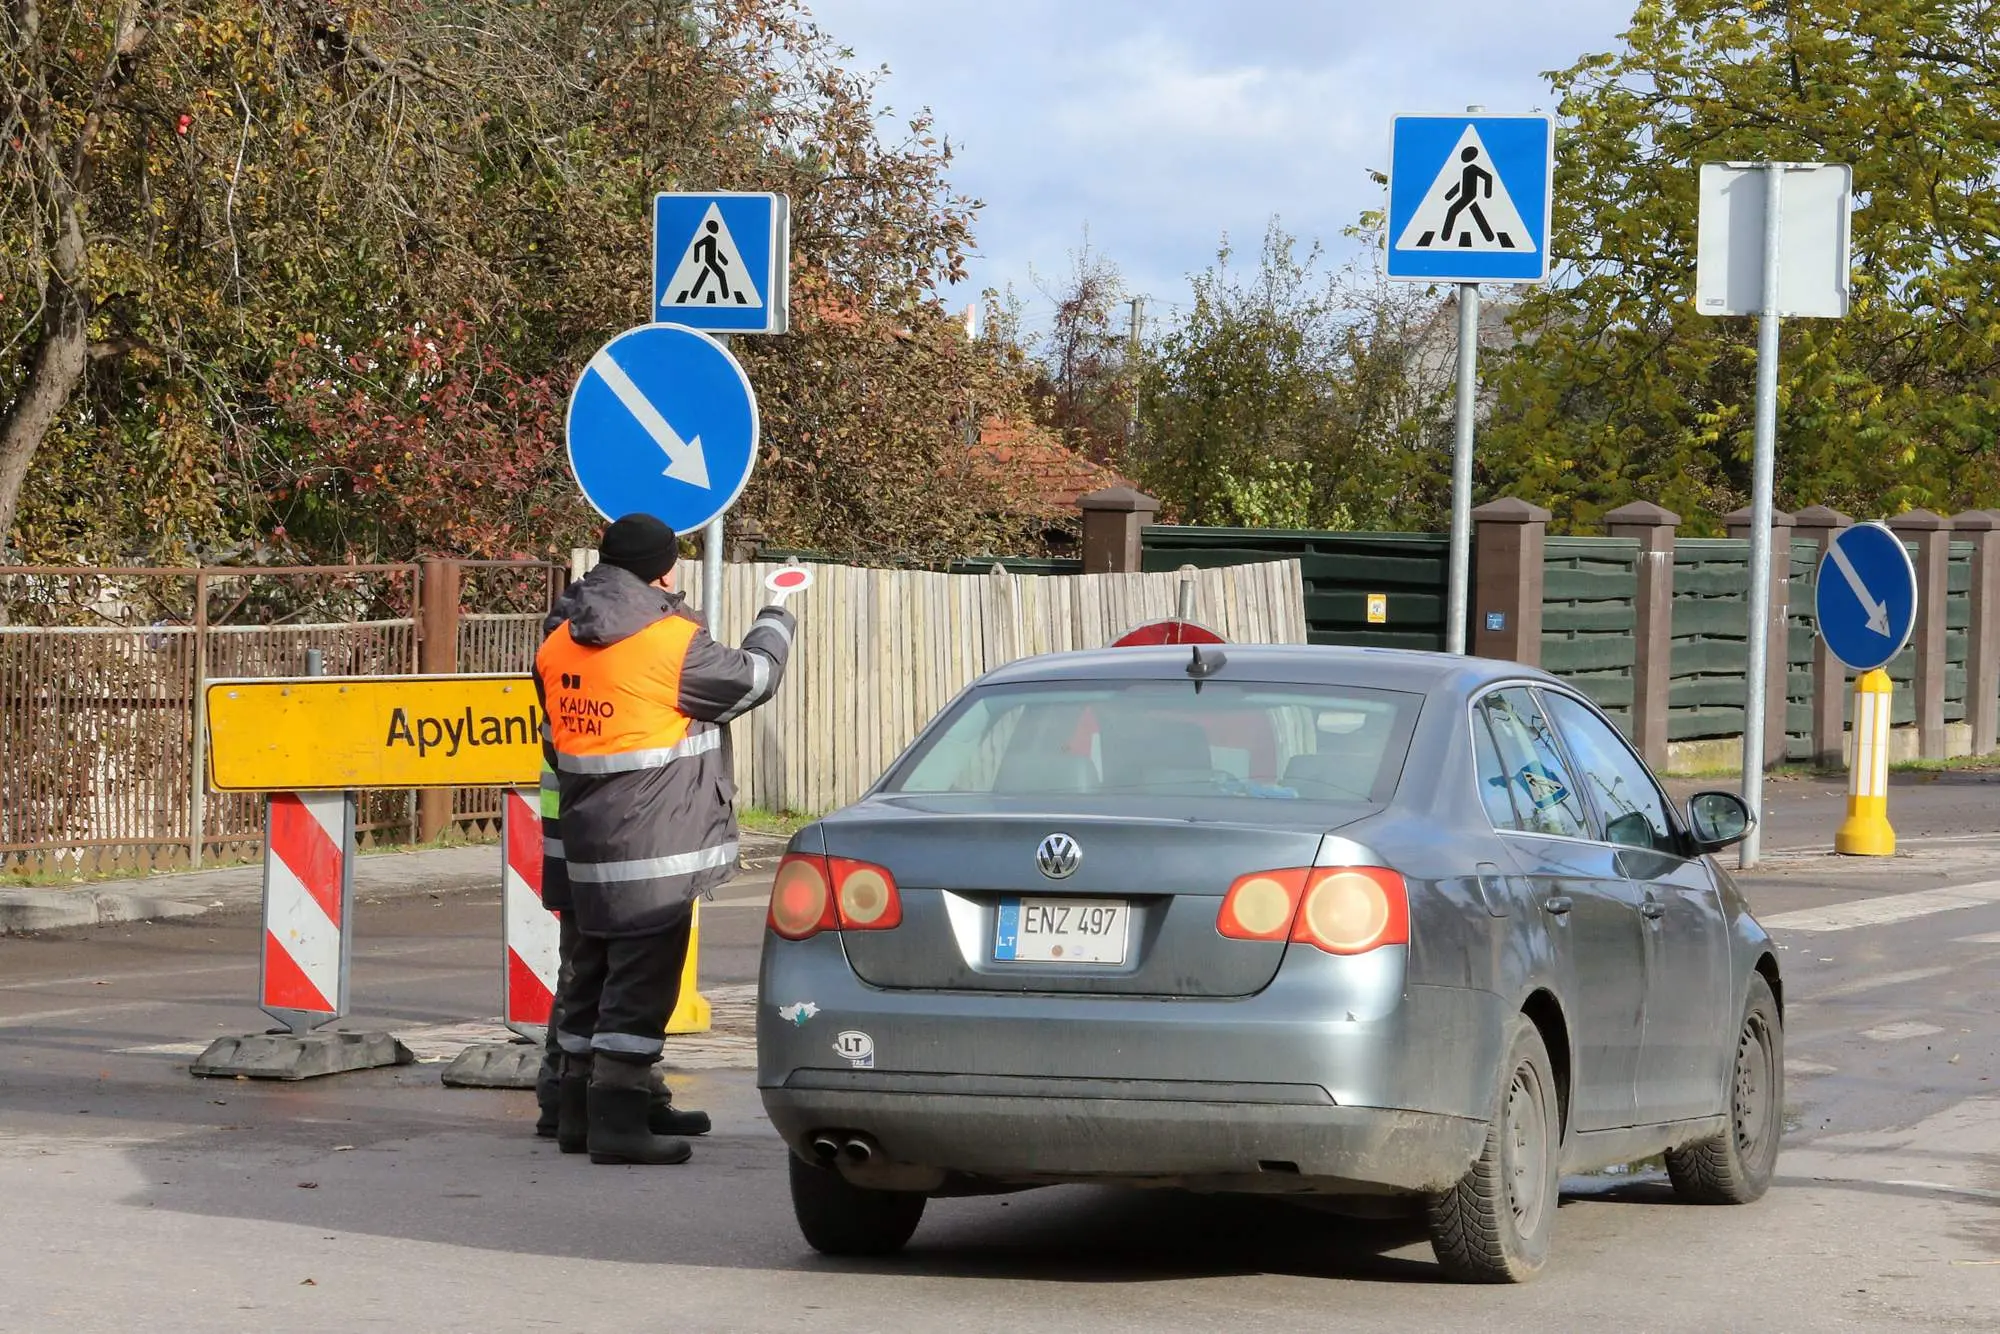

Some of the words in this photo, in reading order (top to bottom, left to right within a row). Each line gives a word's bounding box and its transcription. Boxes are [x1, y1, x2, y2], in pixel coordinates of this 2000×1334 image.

[560, 697, 614, 718] KAUNO
[1025, 906, 1071, 934] ENZ
[1077, 907, 1117, 935] 497
[998, 935, 1015, 947] LT
[844, 1038, 862, 1052] LT
